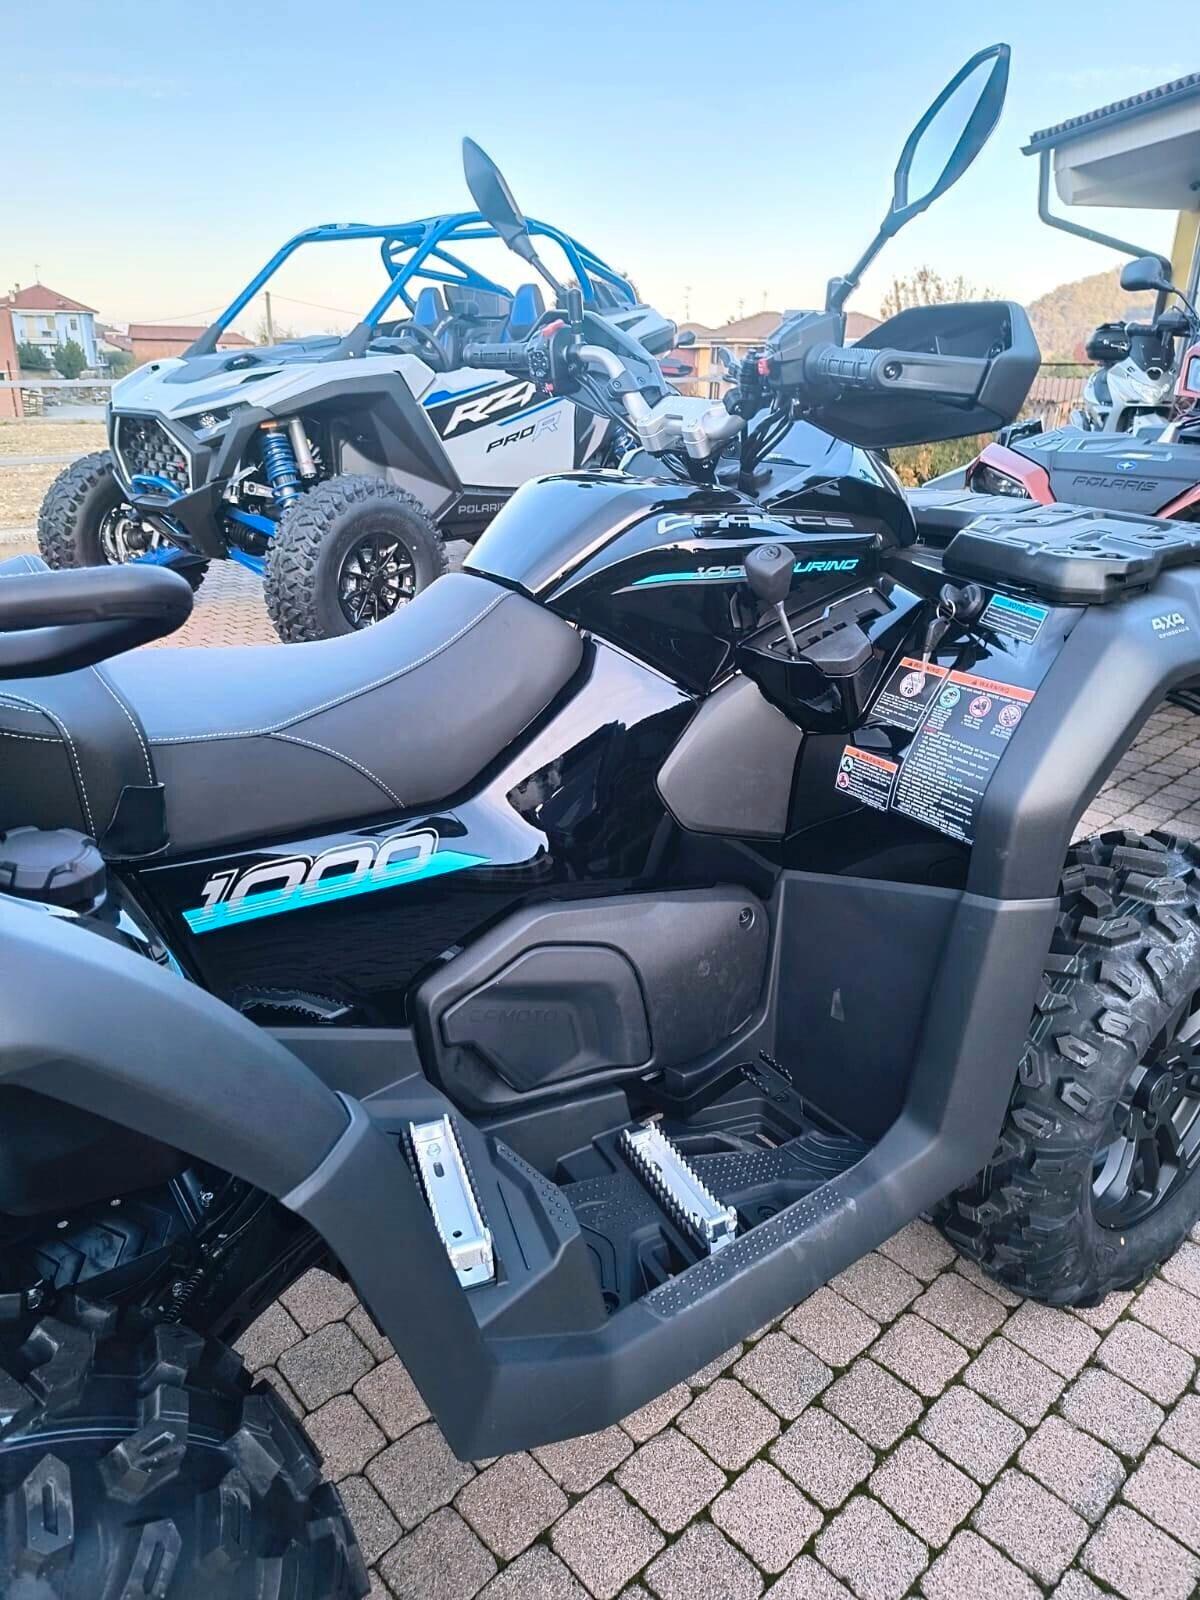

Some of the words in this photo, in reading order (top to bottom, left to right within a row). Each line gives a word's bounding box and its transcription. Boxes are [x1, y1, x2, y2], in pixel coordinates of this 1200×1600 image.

[1072, 476, 1158, 492] POLARIS
[979, 679, 1010, 694] WARNING
[200, 827, 440, 917] 1000
